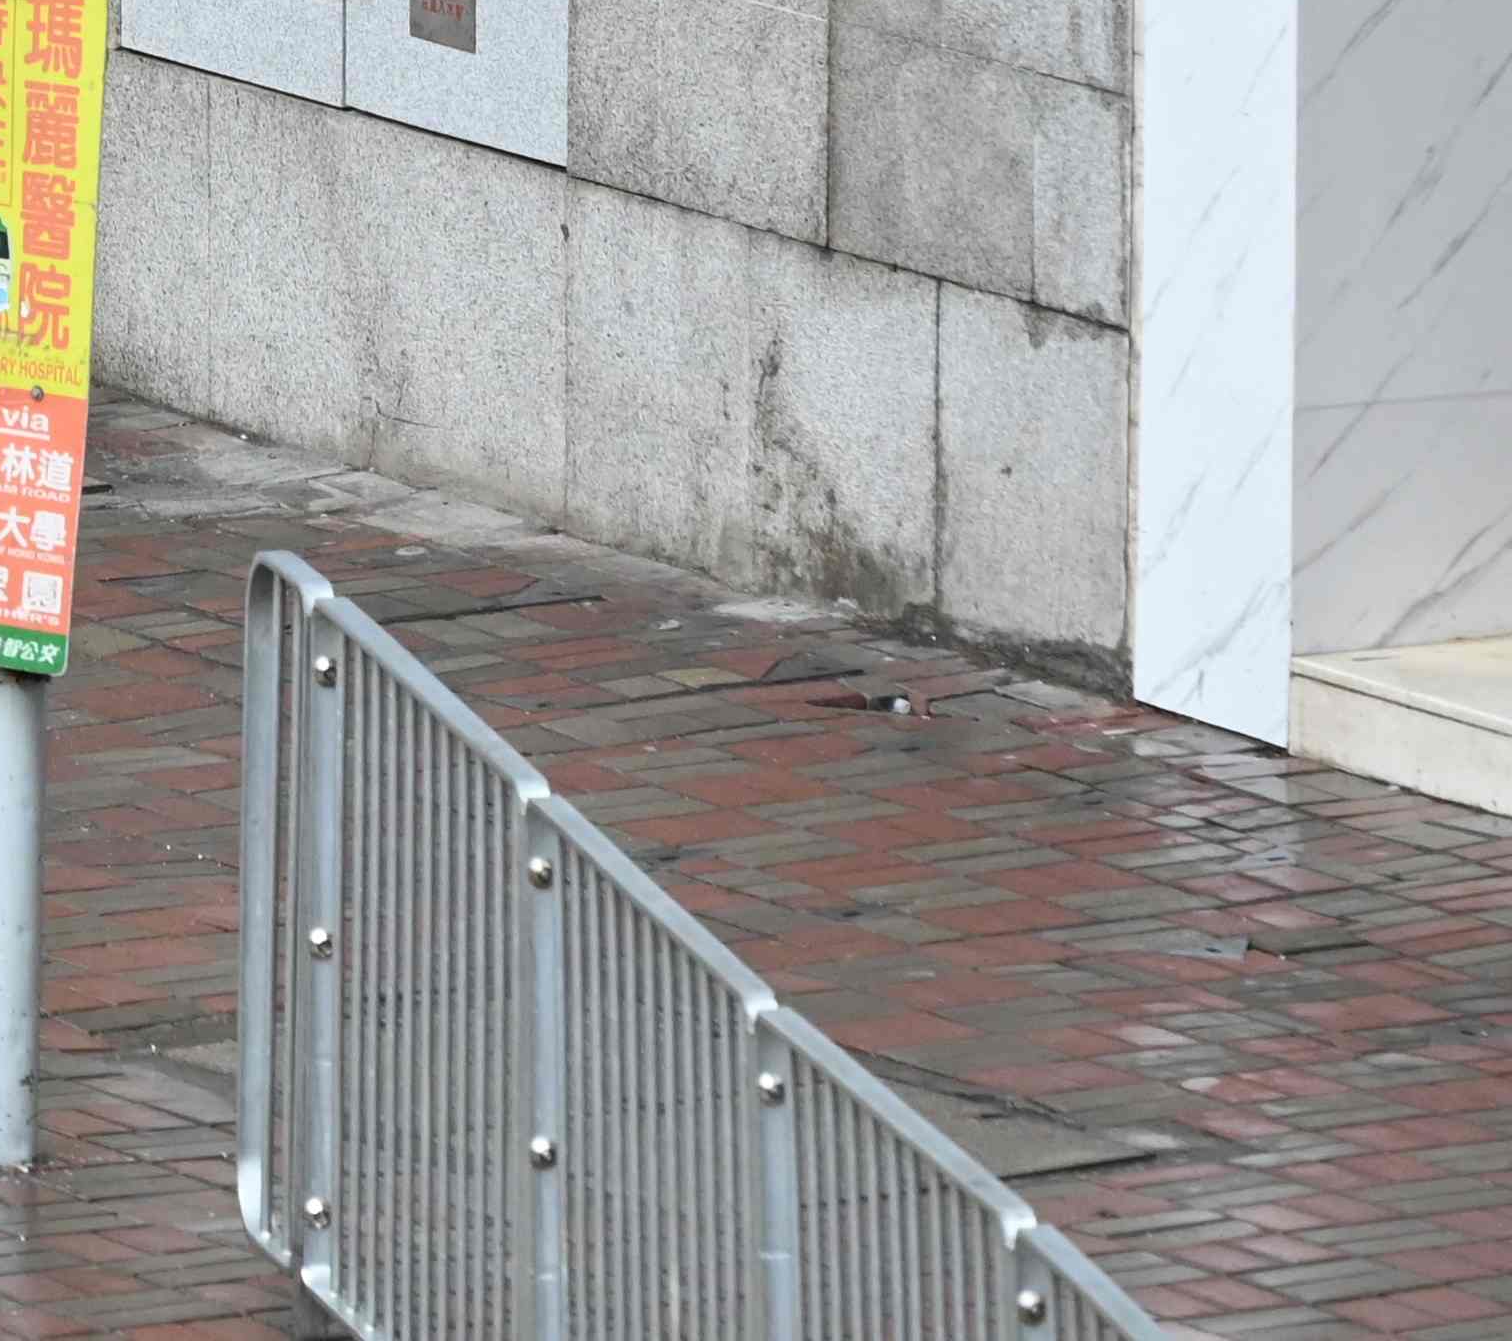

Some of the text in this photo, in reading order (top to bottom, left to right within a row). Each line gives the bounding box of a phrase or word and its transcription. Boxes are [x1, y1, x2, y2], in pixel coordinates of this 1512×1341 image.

[18, 358, 82, 386] HOSPITAL
[1, 404, 50, 433] via
[20, 486, 72, 504] ROAD
